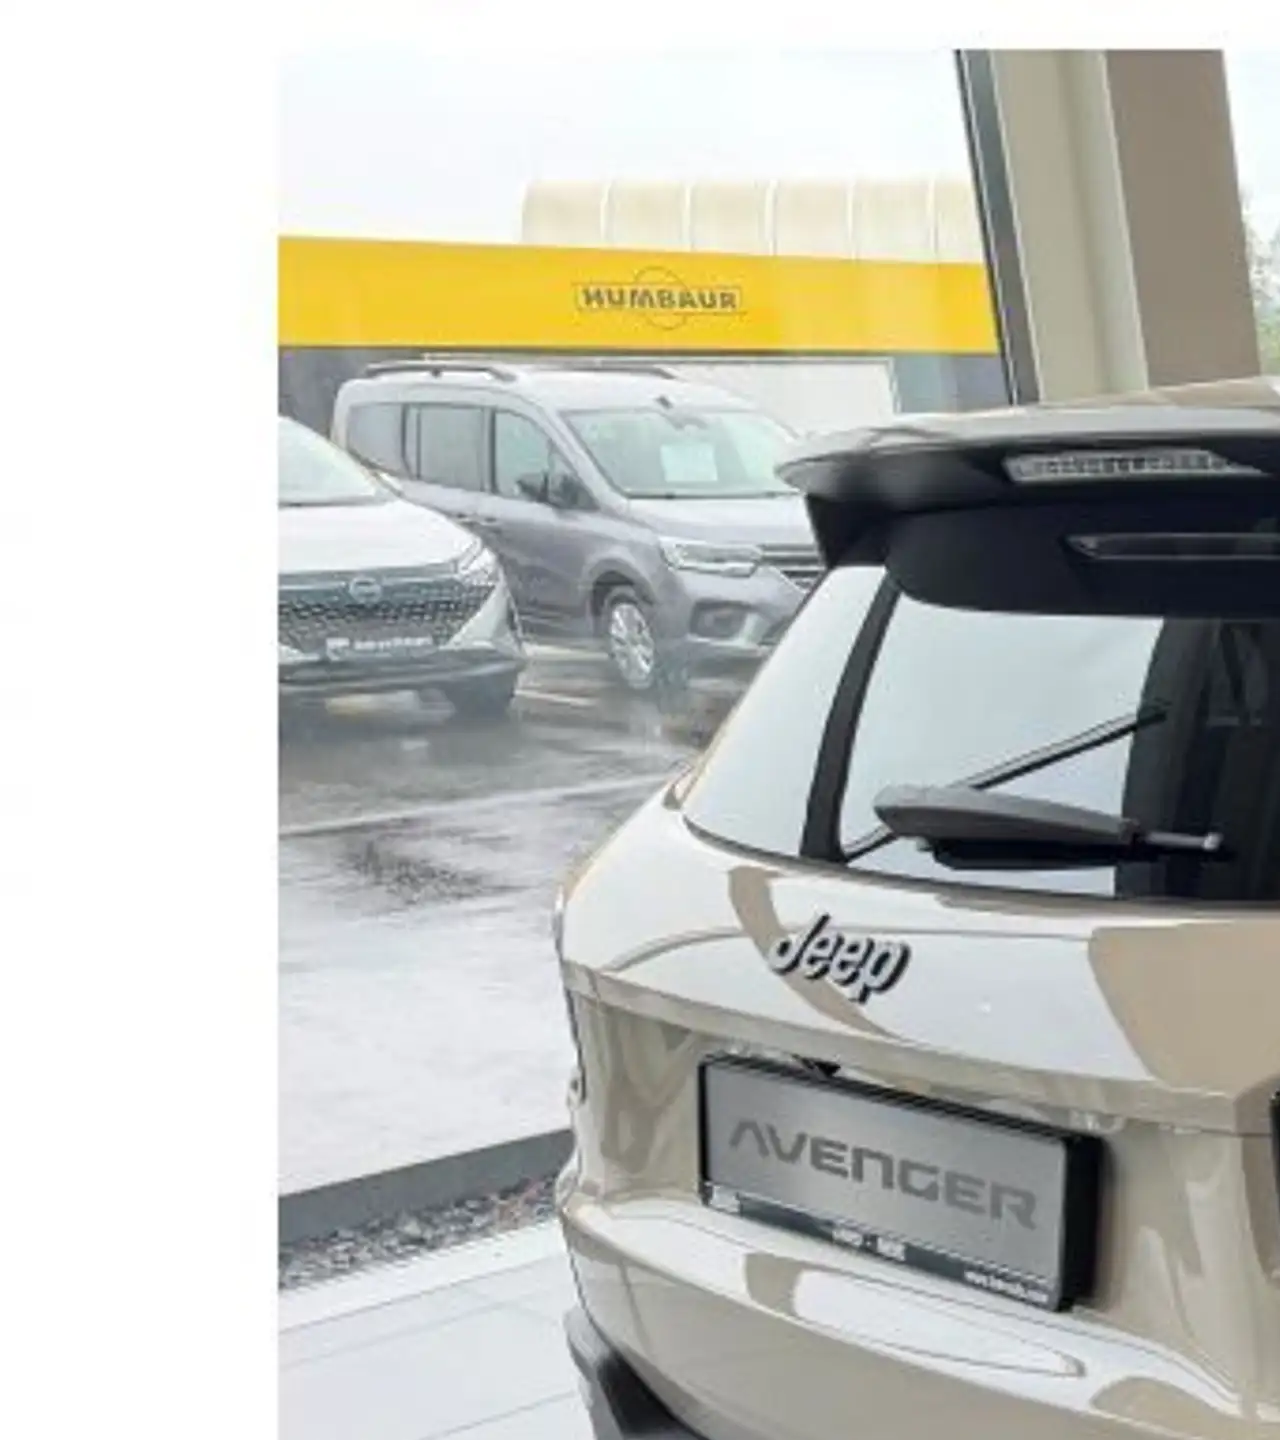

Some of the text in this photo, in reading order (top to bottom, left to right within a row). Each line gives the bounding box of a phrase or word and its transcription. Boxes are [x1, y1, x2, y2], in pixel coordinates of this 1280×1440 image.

[582, 288, 738, 310] HUMBAUR
[770, 913, 912, 1002] Jeep
[729, 1119, 1039, 1232] AVENGER
